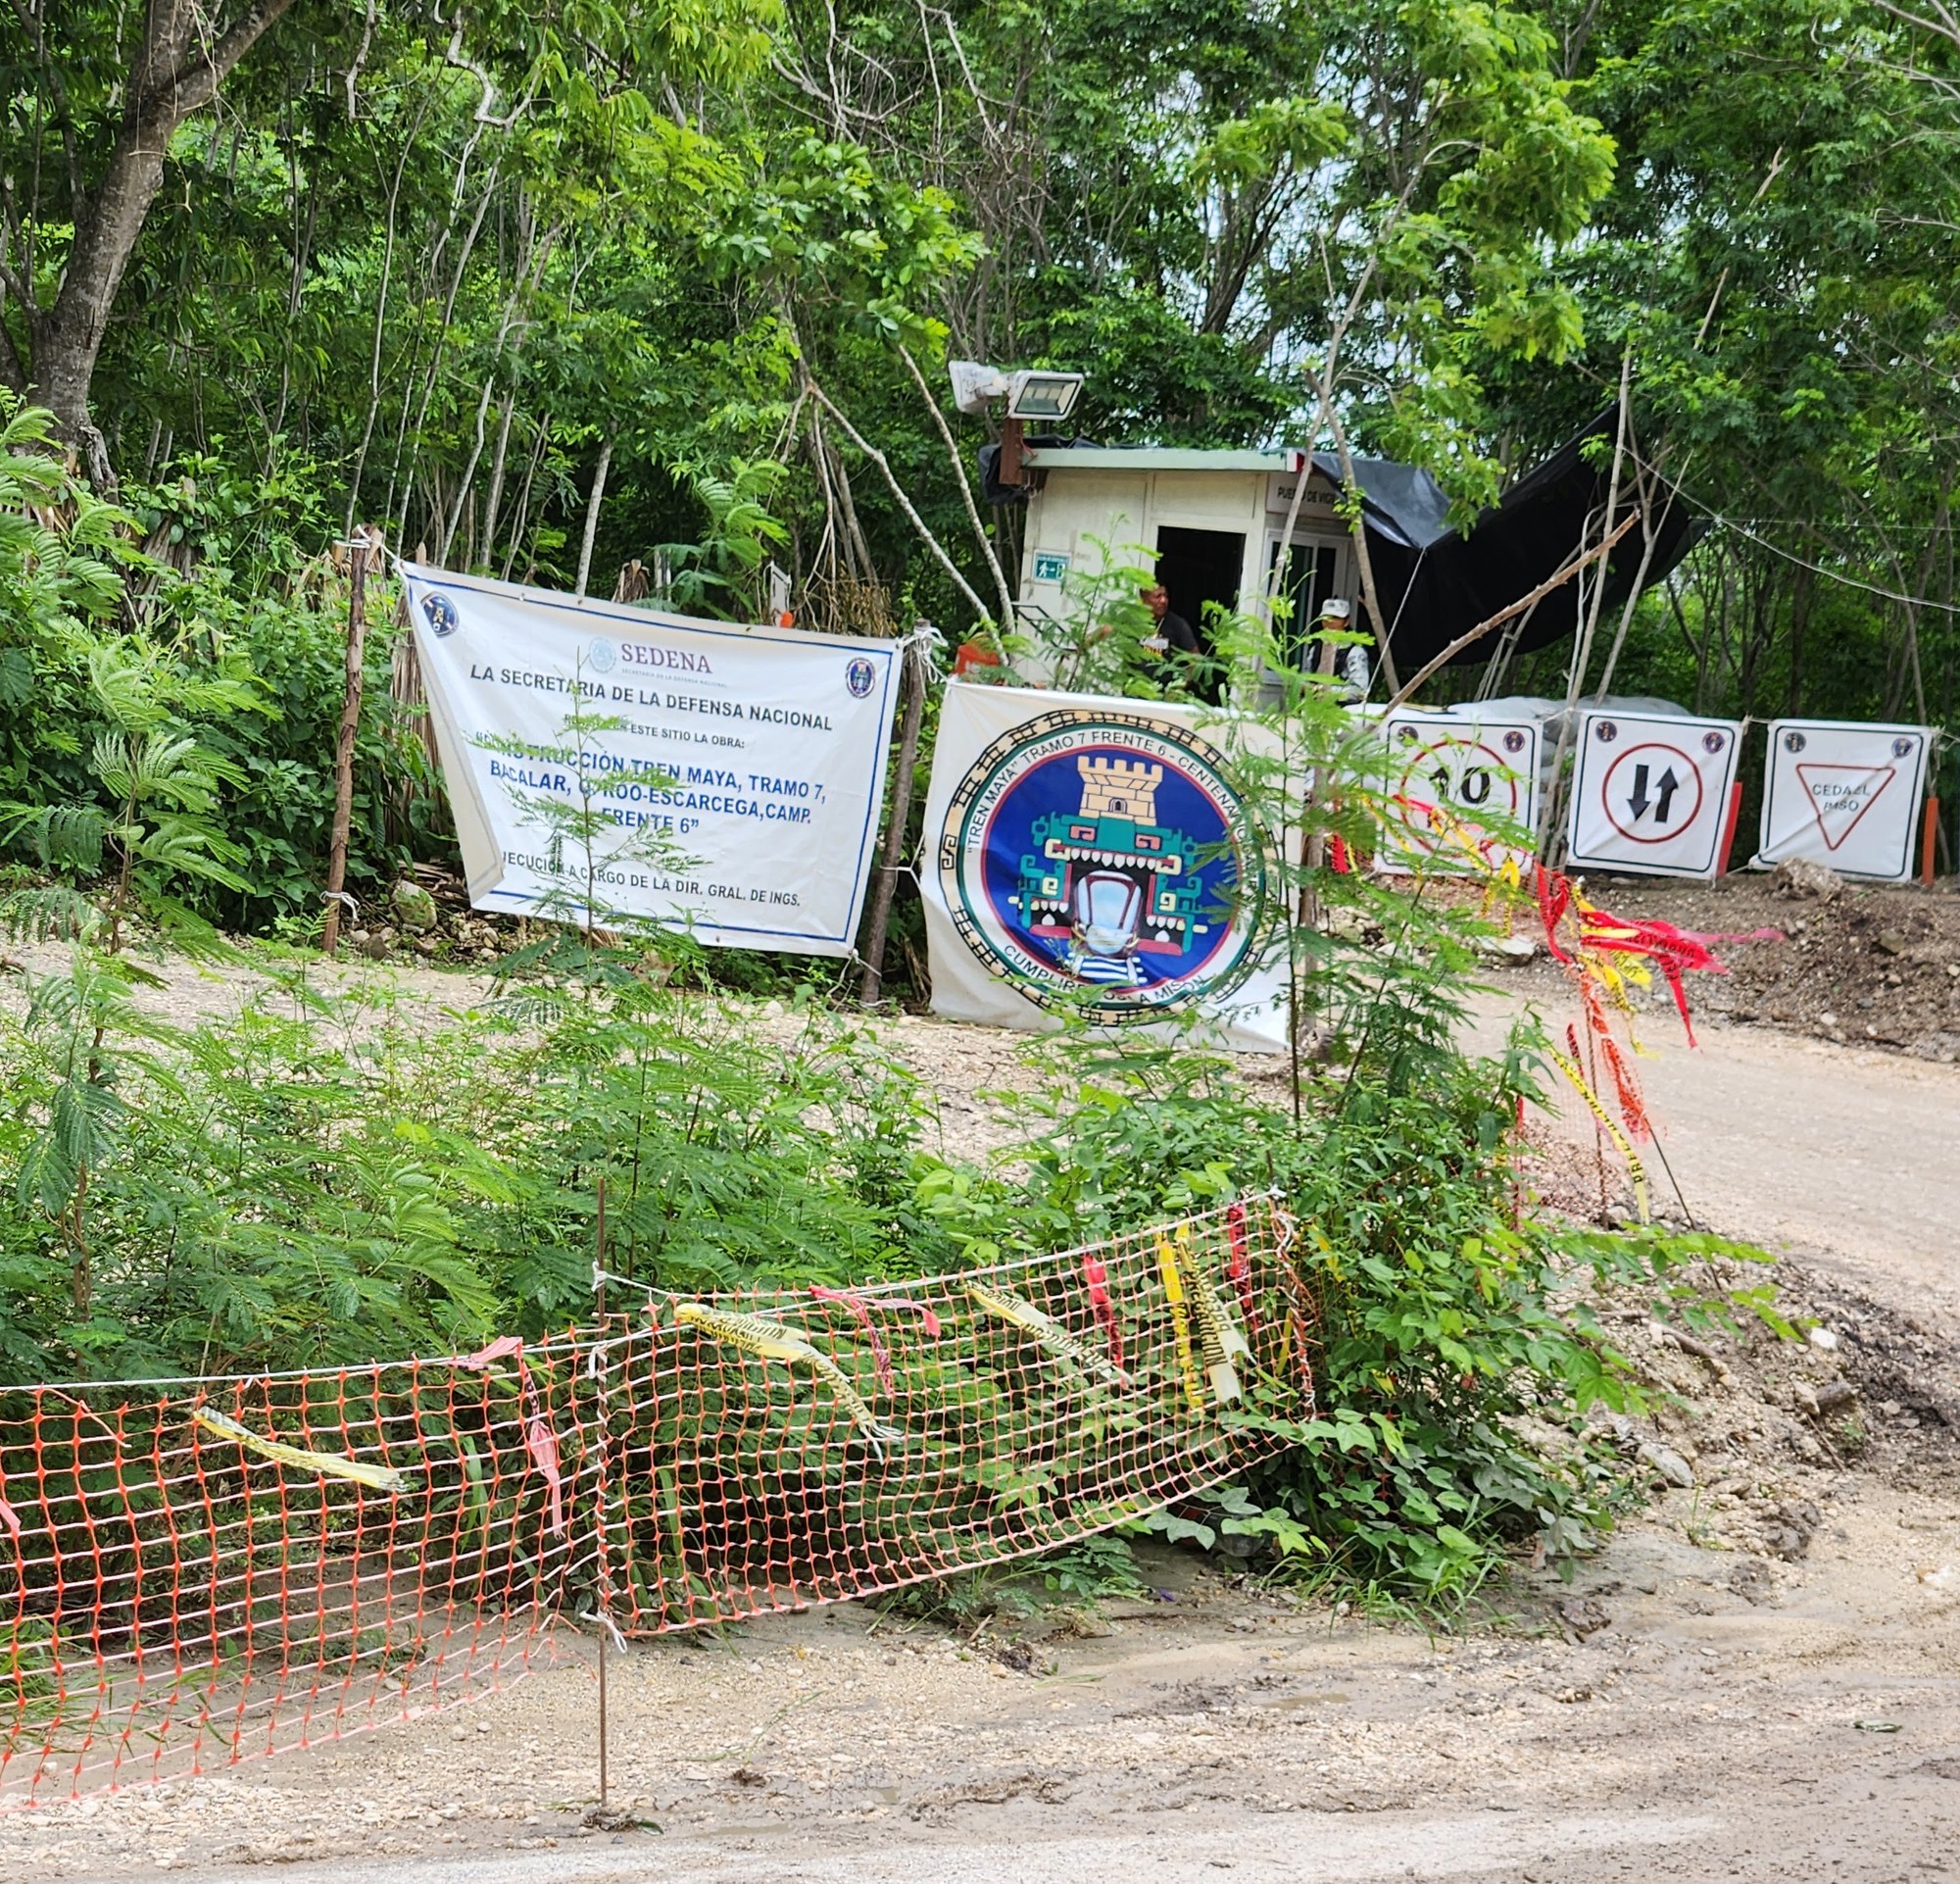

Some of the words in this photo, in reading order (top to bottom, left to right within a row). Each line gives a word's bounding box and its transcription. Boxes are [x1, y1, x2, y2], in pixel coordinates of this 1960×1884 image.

[621, 643, 713, 674] SEDENA
[470, 664, 495, 682] LA
[612, 686, 634, 703] DE
[639, 690, 661, 707] LA
[666, 694, 744, 719] DEFENSA
[749, 705, 833, 731] NACIONAL
[630, 723, 659, 737] ESTE
[662, 728, 691, 742] SITIO
[694, 733, 708, 744] LA
[711, 735, 746, 749] OBRA:
[1019, 735, 1074, 764] TRAMO
[1077, 732, 1086, 745] 7
[1092, 731, 1154, 751] FRENTE
[1157, 745, 1166, 757] 6
[490, 760, 572, 796] BACALAR,
[687, 767, 742, 793] MAYA,
[749, 774, 809, 798] TRAMO
[814, 784, 827, 805] 7,
[1812, 783, 1851, 797] CEDA
[568, 865, 576, 876] A
[630, 874, 649, 888] DE
[653, 877, 670, 891] LA
[675, 880, 703, 895] DIR.
[708, 884, 746, 901] GRAL.
[750, 889, 767, 903] DE
[769, 891, 801, 907] INGS.
